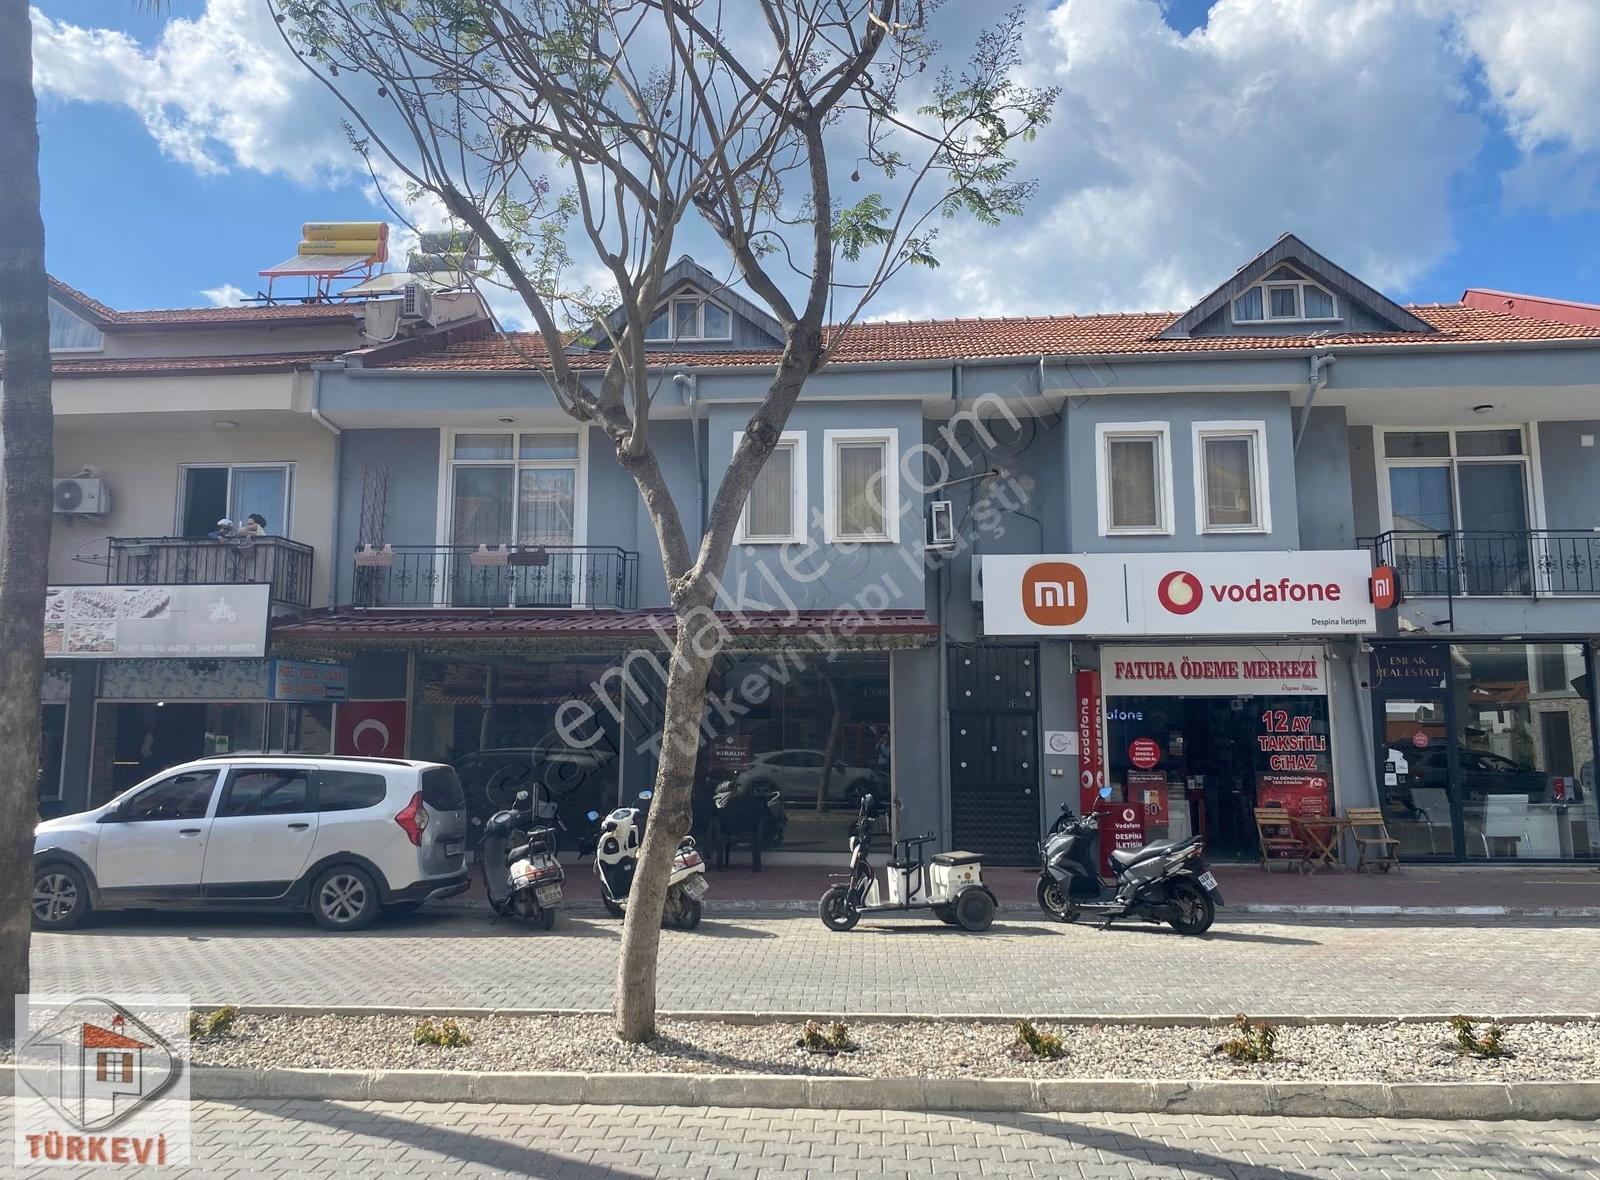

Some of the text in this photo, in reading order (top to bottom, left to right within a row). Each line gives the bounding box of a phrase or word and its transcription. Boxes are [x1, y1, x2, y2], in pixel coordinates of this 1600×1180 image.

[1211, 578, 1341, 602] vodafone
[1311, 616, 1367, 628] Despina İletişim
[1115, 655, 1318, 680] FATURA ÖDEME MERKEZİ
[1080, 697, 1089, 765] vodafone
[1262, 710, 1312, 732] 12 AY
[1115, 831, 1142, 840] DESPİNA
